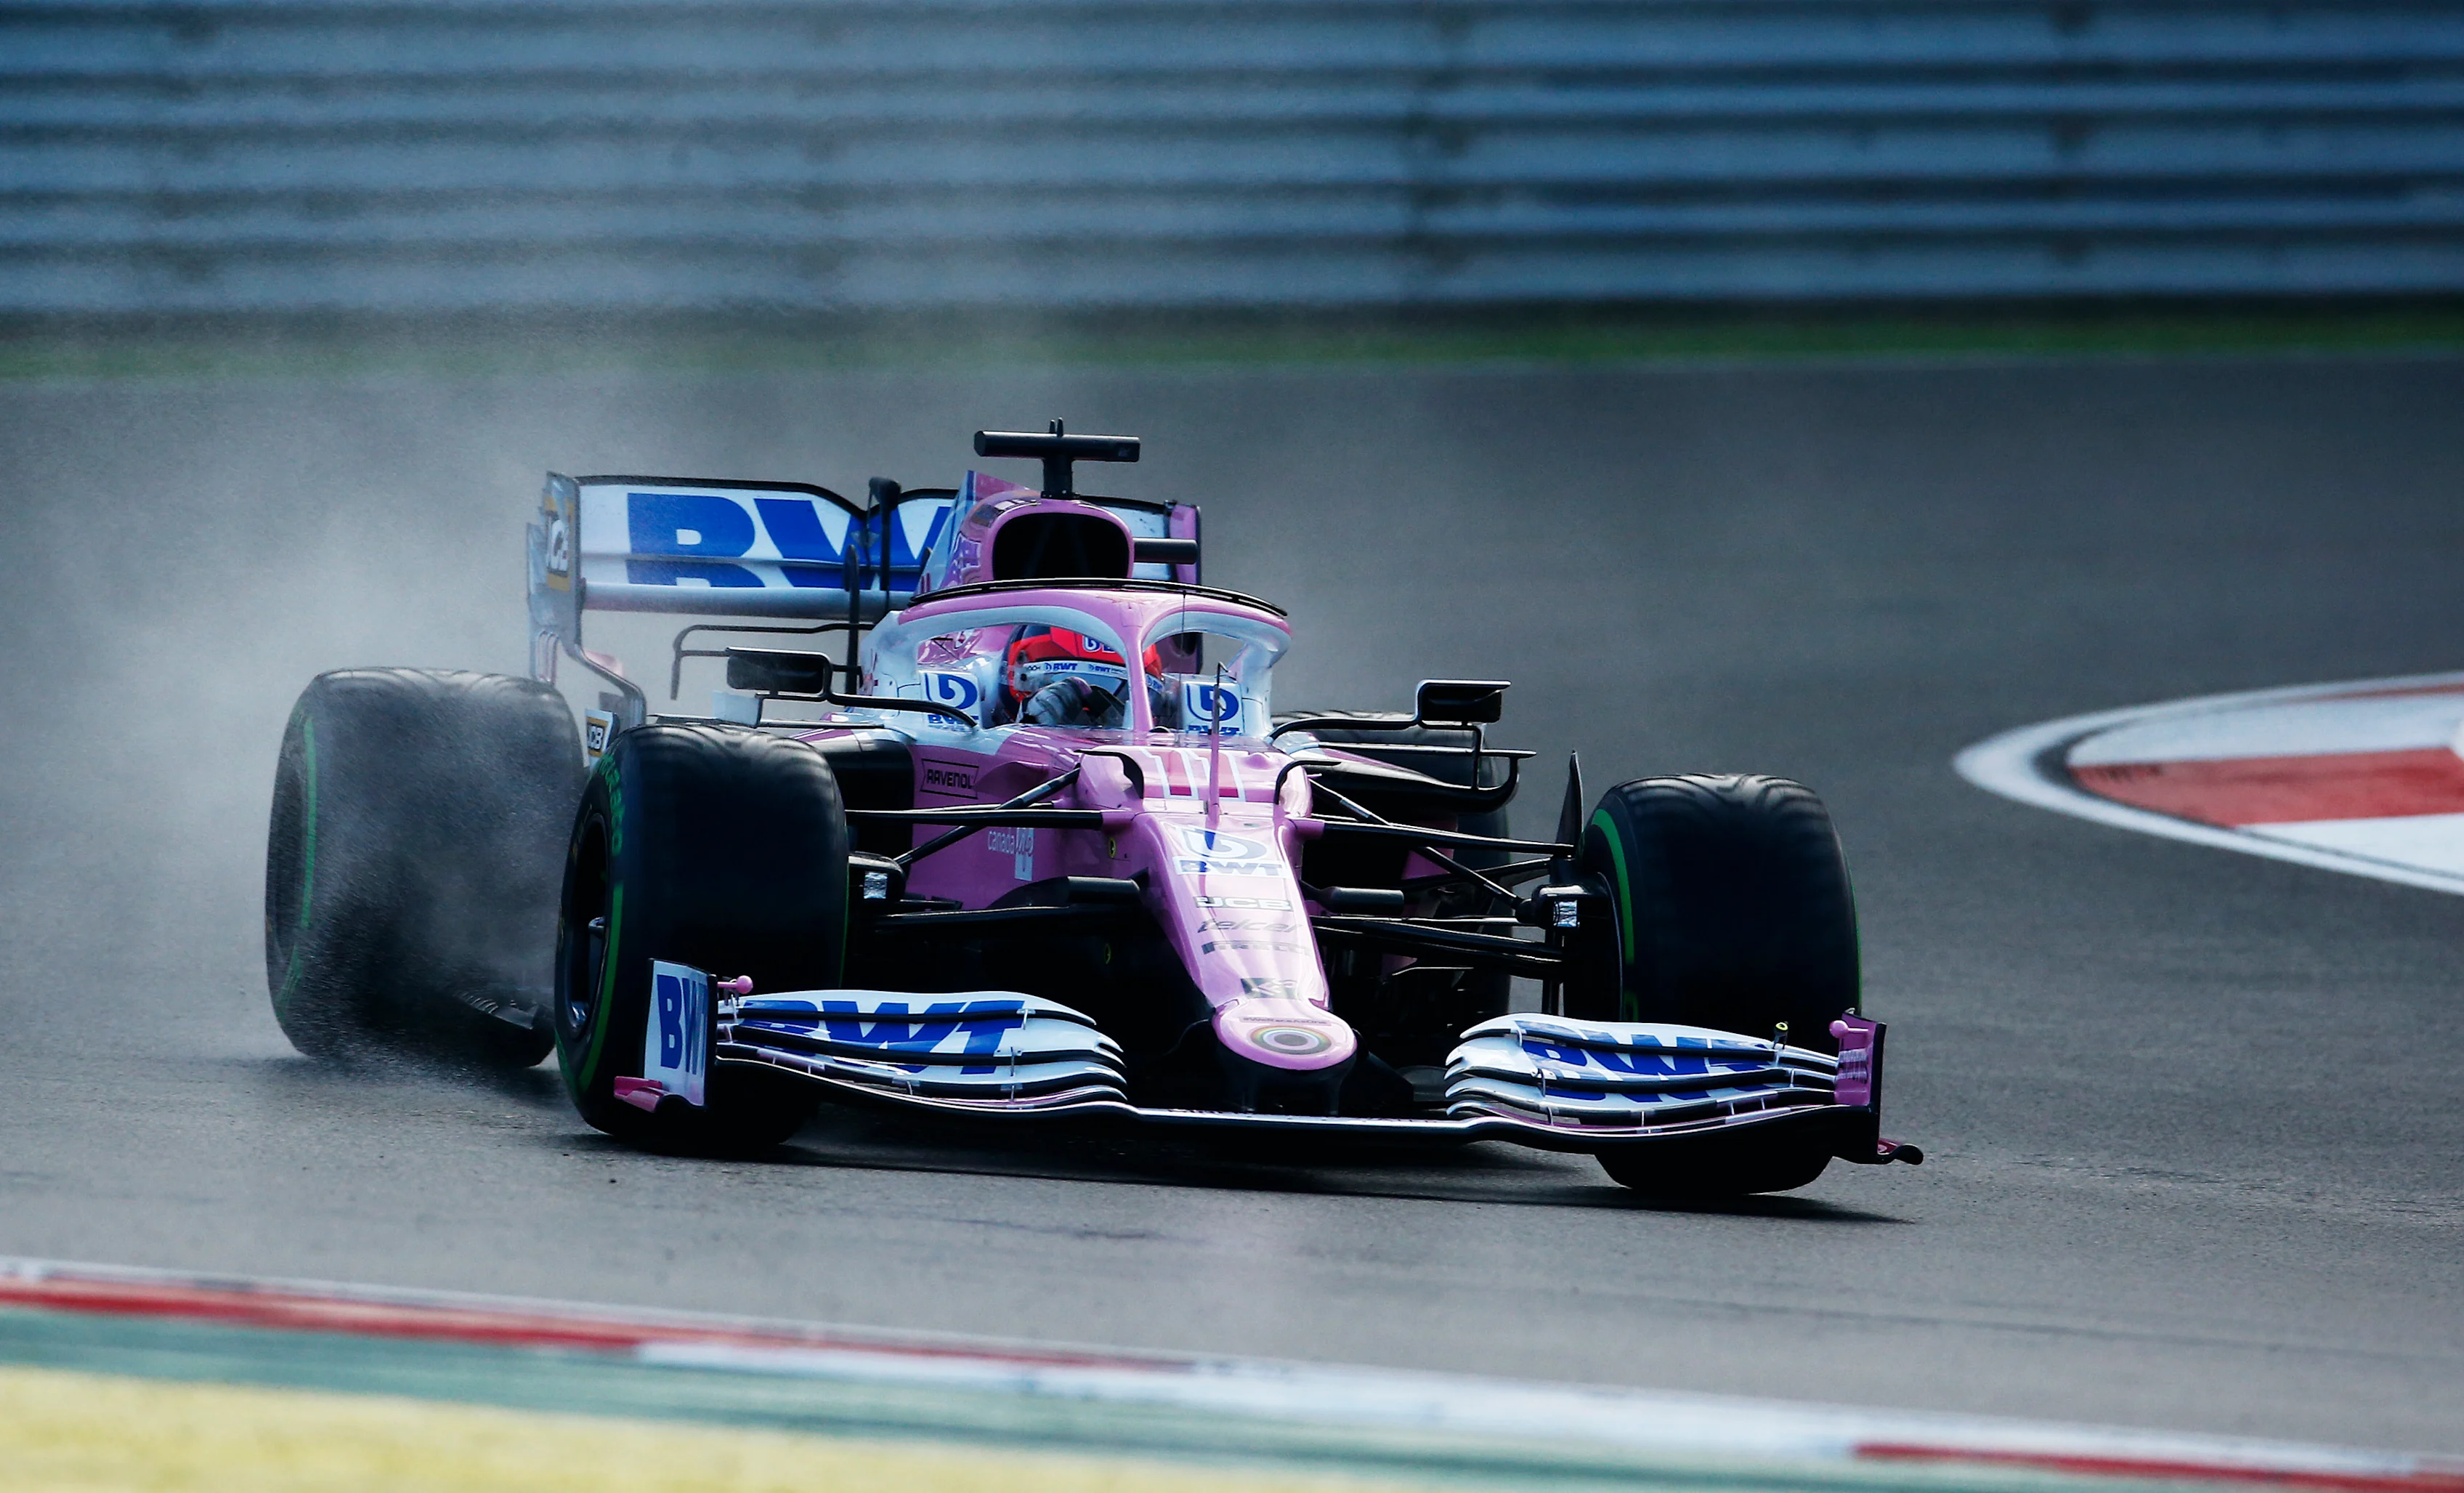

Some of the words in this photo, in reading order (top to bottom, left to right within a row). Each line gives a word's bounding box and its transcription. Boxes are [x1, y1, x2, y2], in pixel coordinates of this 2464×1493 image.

[628, 493, 953, 592] BW
[926, 769, 974, 790] RAVENOL
[1179, 859, 1283, 876] BWT
[1196, 897, 1293, 911] JCB
[657, 974, 708, 1077] BWT
